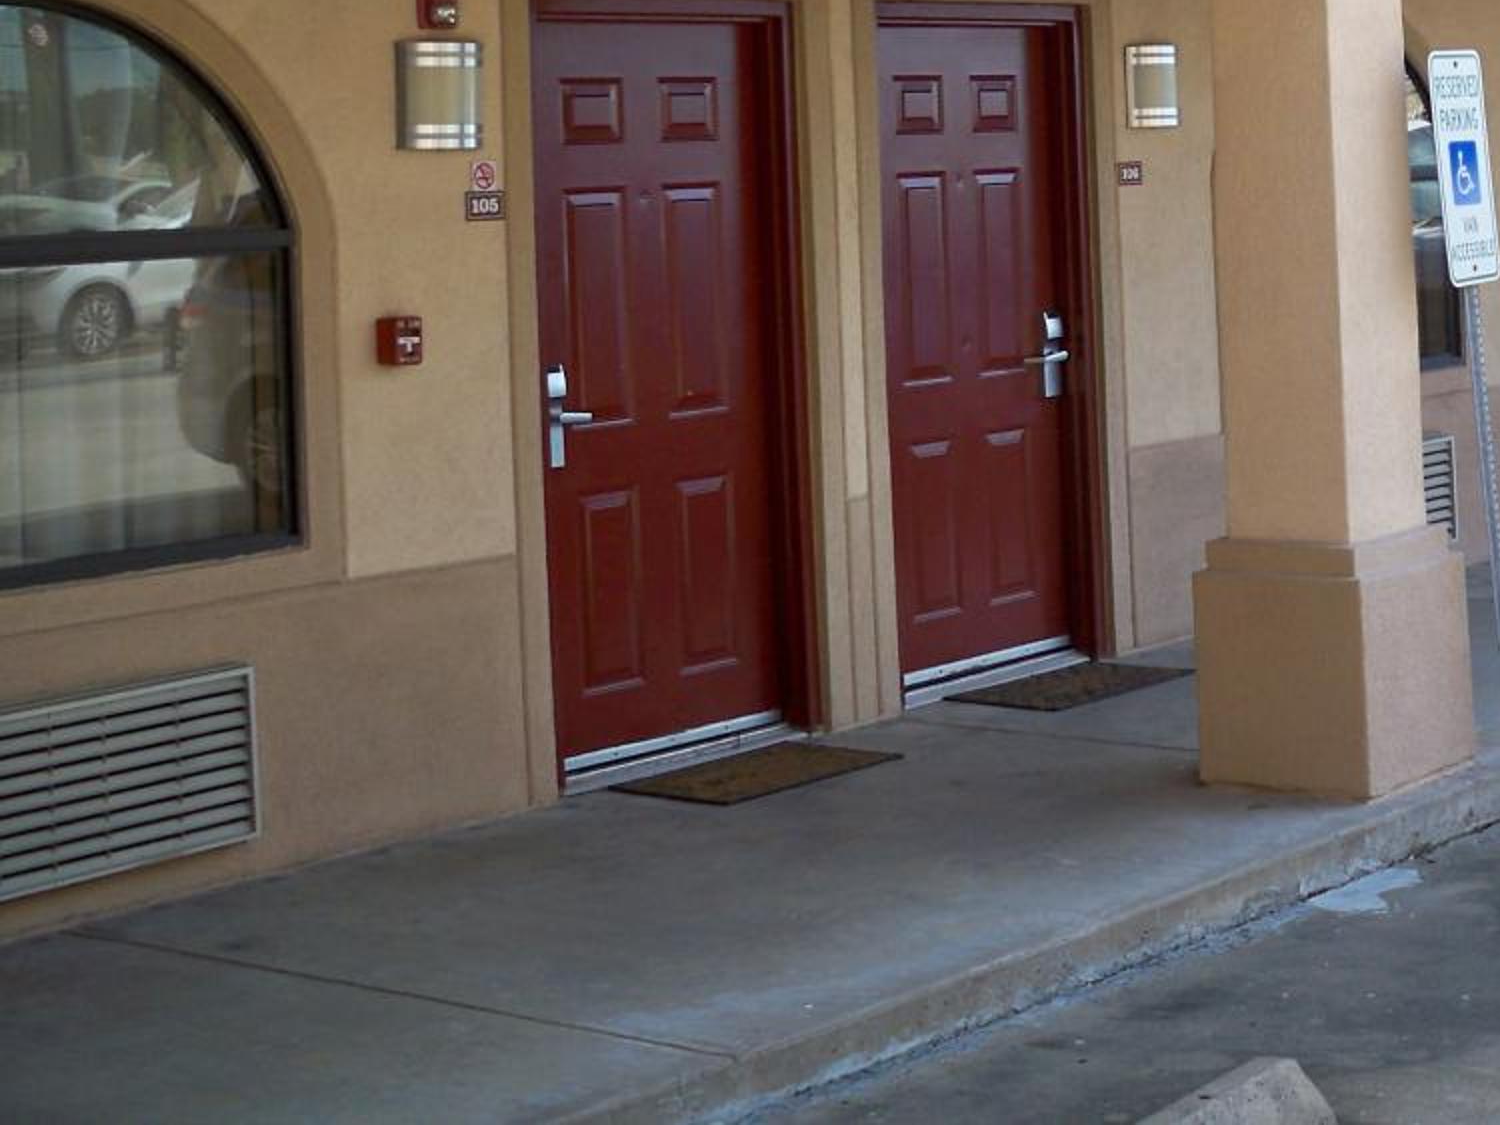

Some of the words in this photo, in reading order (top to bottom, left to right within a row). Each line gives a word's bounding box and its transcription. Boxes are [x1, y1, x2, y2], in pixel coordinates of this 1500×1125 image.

[1434, 74, 1478, 97] RESERVED
[1439, 107, 1478, 130] PARKING
[471, 198, 499, 214] 105
